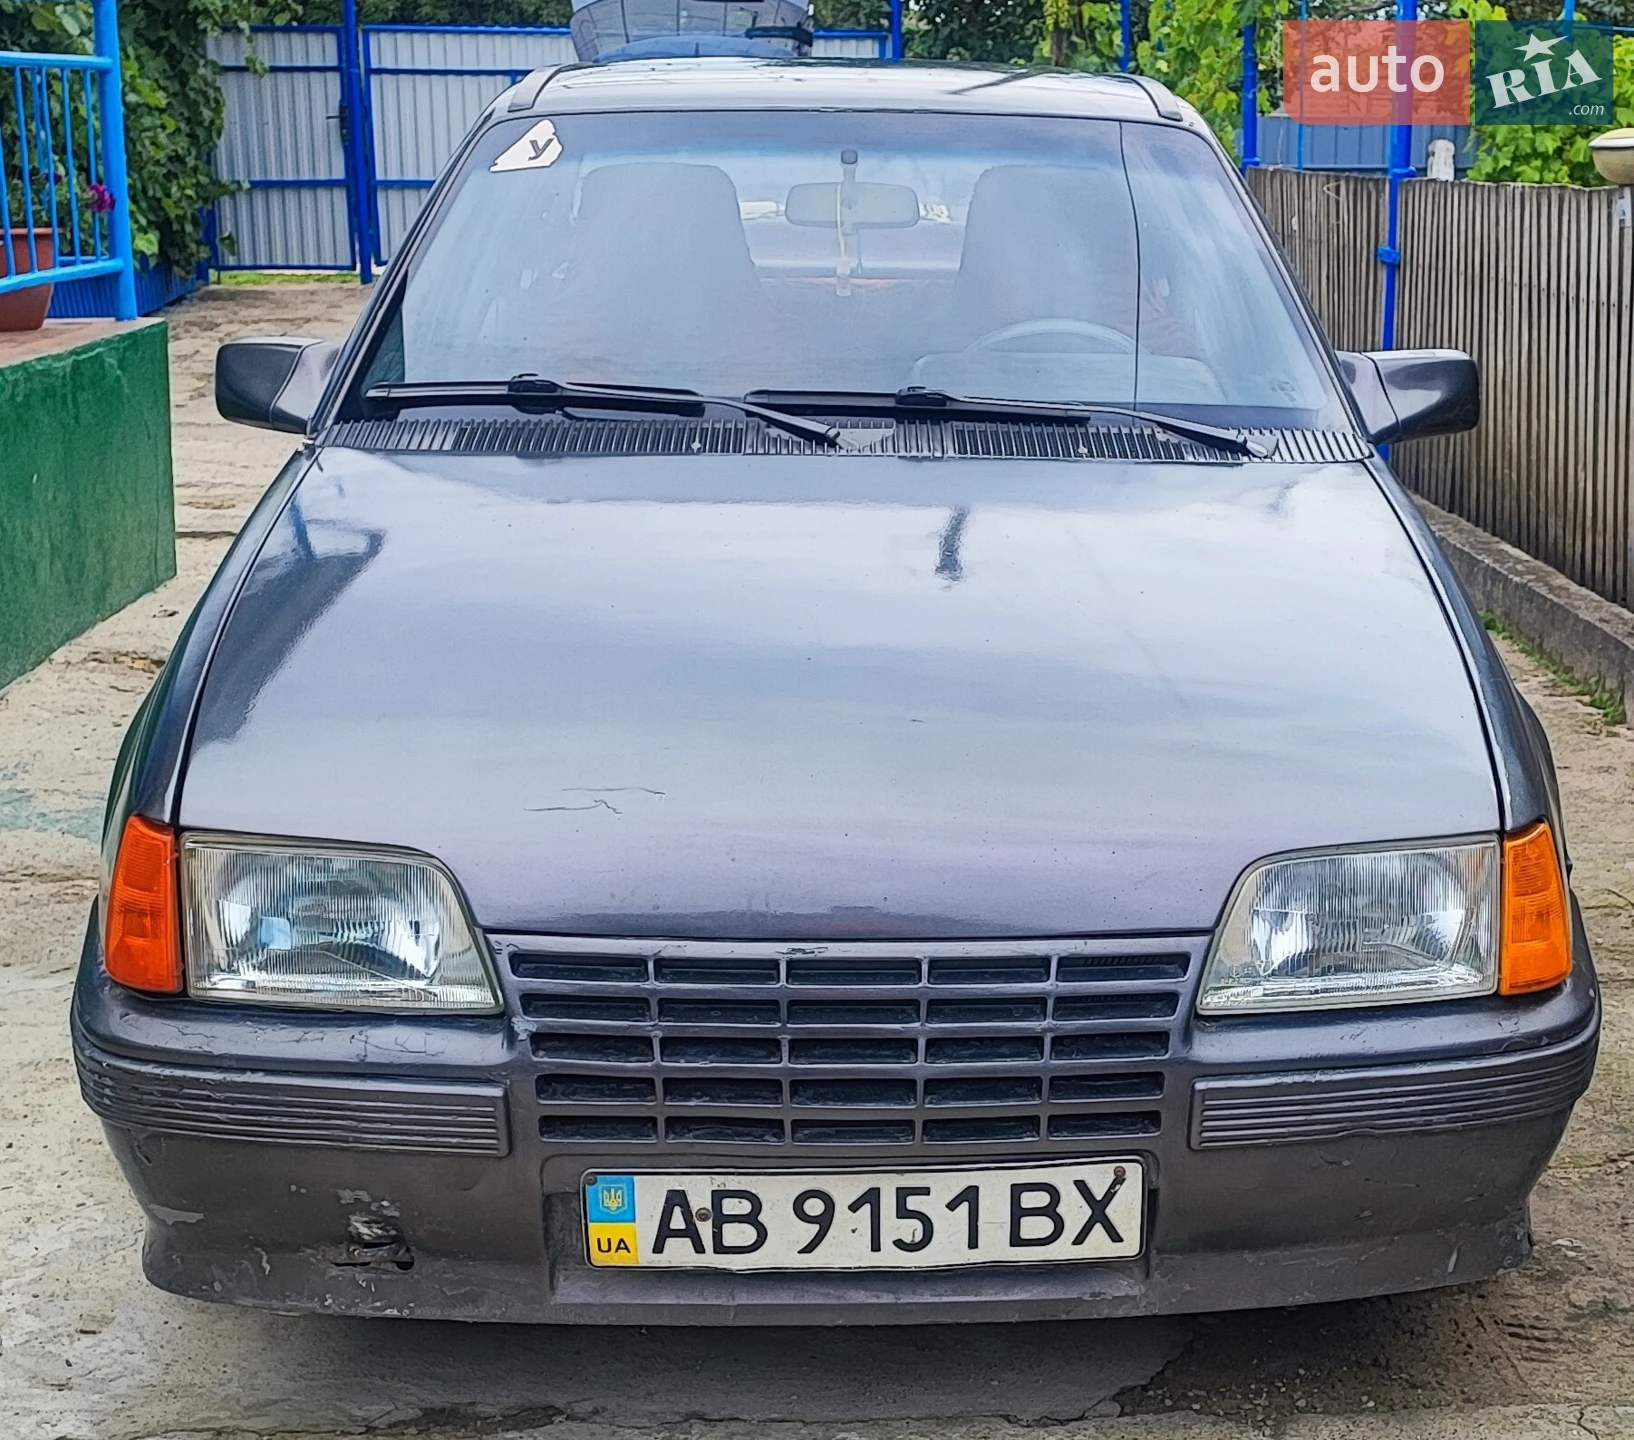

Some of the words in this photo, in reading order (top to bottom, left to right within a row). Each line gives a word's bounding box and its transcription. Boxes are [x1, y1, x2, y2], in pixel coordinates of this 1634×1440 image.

[652, 1189, 769, 1255] AB
[792, 1185, 979, 1254] 9151
[1009, 1178, 1126, 1247] BX
[596, 1236, 632, 1255] UA
